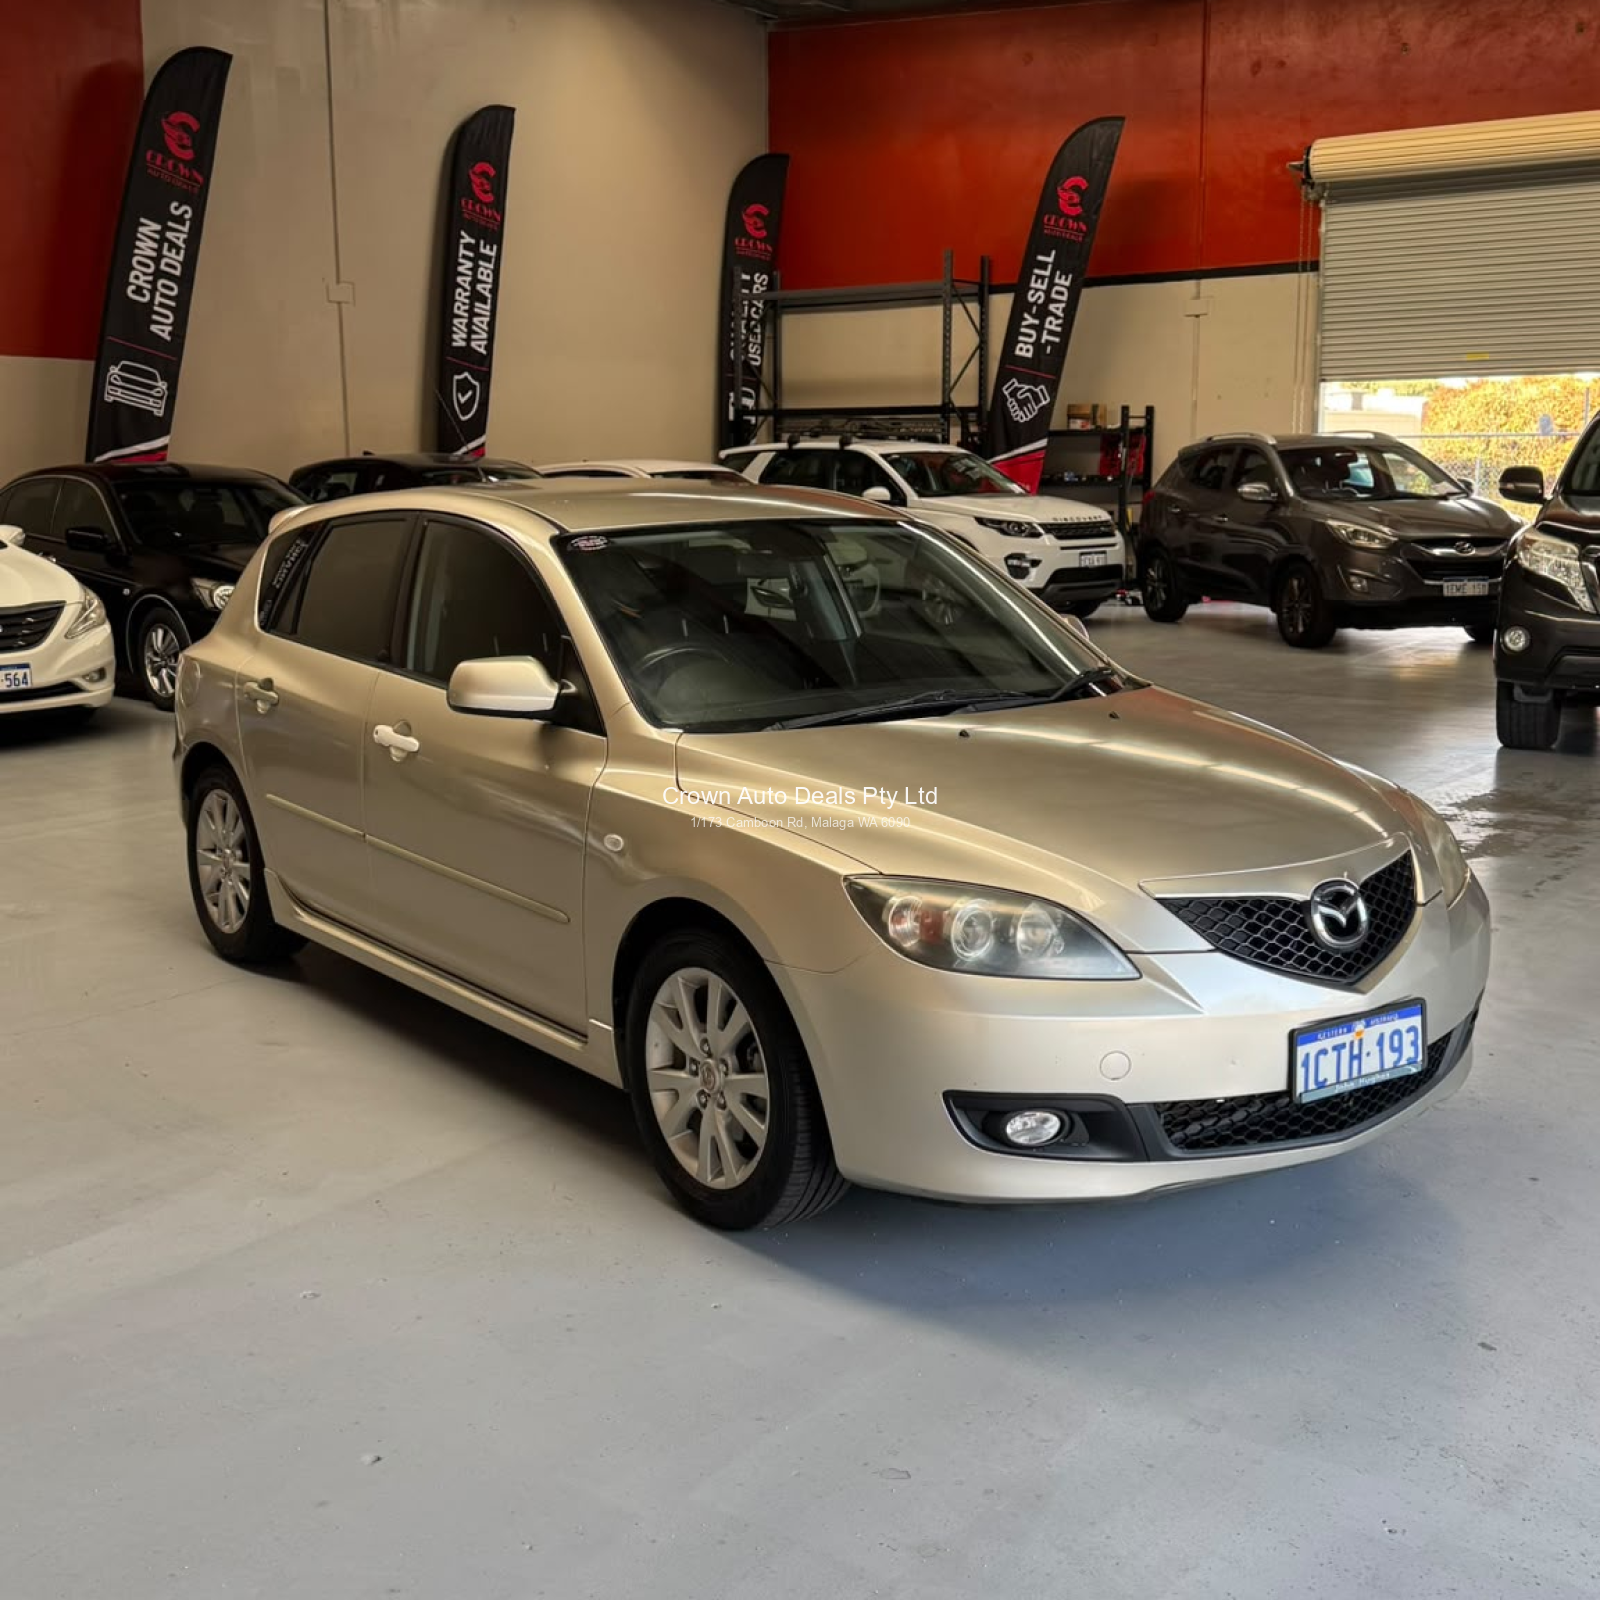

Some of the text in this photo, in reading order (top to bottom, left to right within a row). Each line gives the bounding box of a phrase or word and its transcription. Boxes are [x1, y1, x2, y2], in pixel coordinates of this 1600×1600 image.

[126, 217, 161, 304] CROWN
[150, 201, 192, 341] AUTO DEALS
[452, 231, 476, 348] WARRANTY
[470, 239, 498, 355] AVAILABLE
[1015, 250, 1056, 359] BUY-SELL
[748, 320, 762, 366] USED
